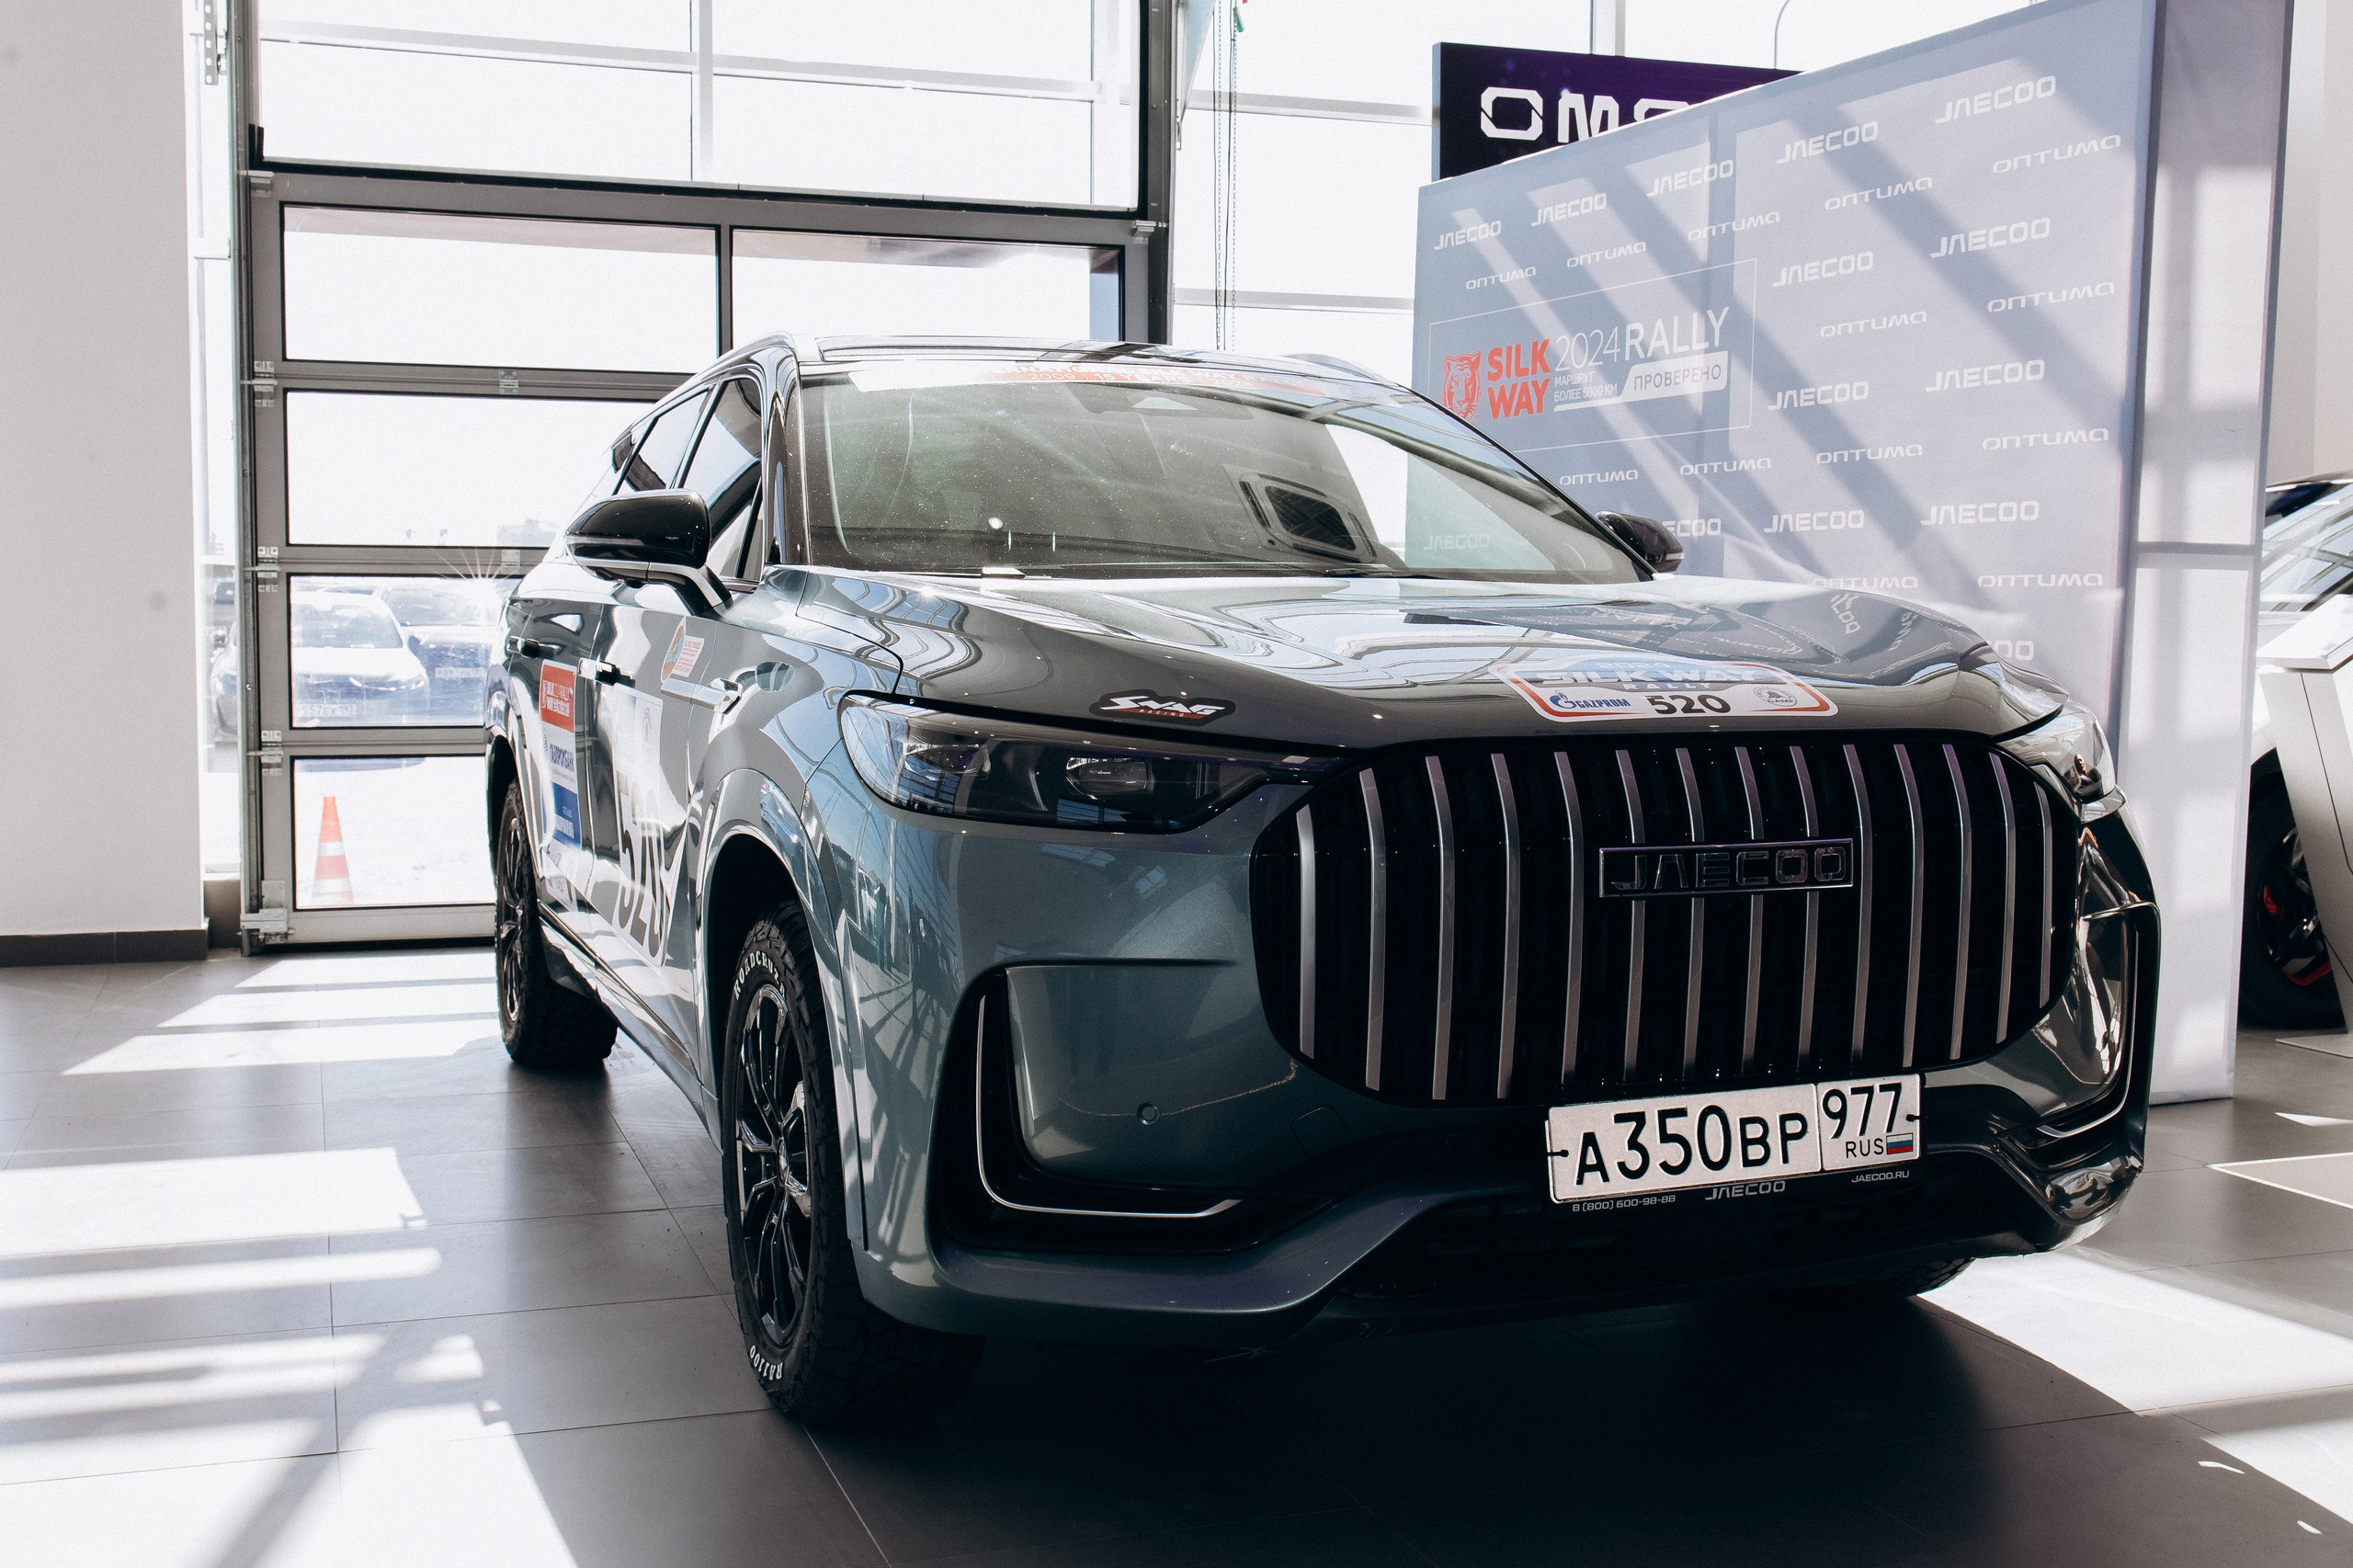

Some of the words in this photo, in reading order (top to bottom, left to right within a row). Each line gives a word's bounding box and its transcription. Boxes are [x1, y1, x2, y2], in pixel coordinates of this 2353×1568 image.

[1934, 74, 2057, 124] JAECOO
[1776, 120, 1880, 165] JAECOO
[1646, 159, 1734, 198] JAECOO
[1530, 193, 1608, 226] JAECOO
[1434, 220, 1503, 250] JAECOO
[1929, 217, 2052, 258] JAECOO
[1771, 251, 1875, 287] JAECOO
[1487, 338, 1551, 381] SILK
[1554, 326, 1620, 372] 2024
[1625, 306, 1729, 361] RALLY
[1554, 370, 1595, 387] МАРШРУТ
[1633, 364, 1722, 392] ПРОВЕРЕНО
[1925, 358, 2045, 392] JAECOO
[1487, 378, 1551, 420] WAY
[1553, 390, 1581, 403] БОЛЕЕ
[1582, 386, 1603, 399] 5000
[1768, 381, 1870, 411] JAECOO
[1764, 509, 1865, 534] JAECOO
[1920, 500, 2040, 527] JAECOO
[1535, 669, 1653, 684] SILK
[1660, 668, 1757, 682] WAY
[1139, 709, 1185, 717] RACING
[1575, 698, 1631, 709] GAZPROM
[1646, 694, 1732, 715] 520
[1611, 846, 1846, 890] JAECOO
[1822, 1082, 1903, 1140] 977
[1846, 1138, 1884, 1159] RUS
[1705, 1180, 1786, 1201] JAECOO
[1851, 1170, 1910, 1183] JAECOO.RU
[1572, 1203, 1580, 1212] 8
[1582, 1199, 1614, 1212] (800)
[1616, 1195, 1676, 1208] 600-98-88
